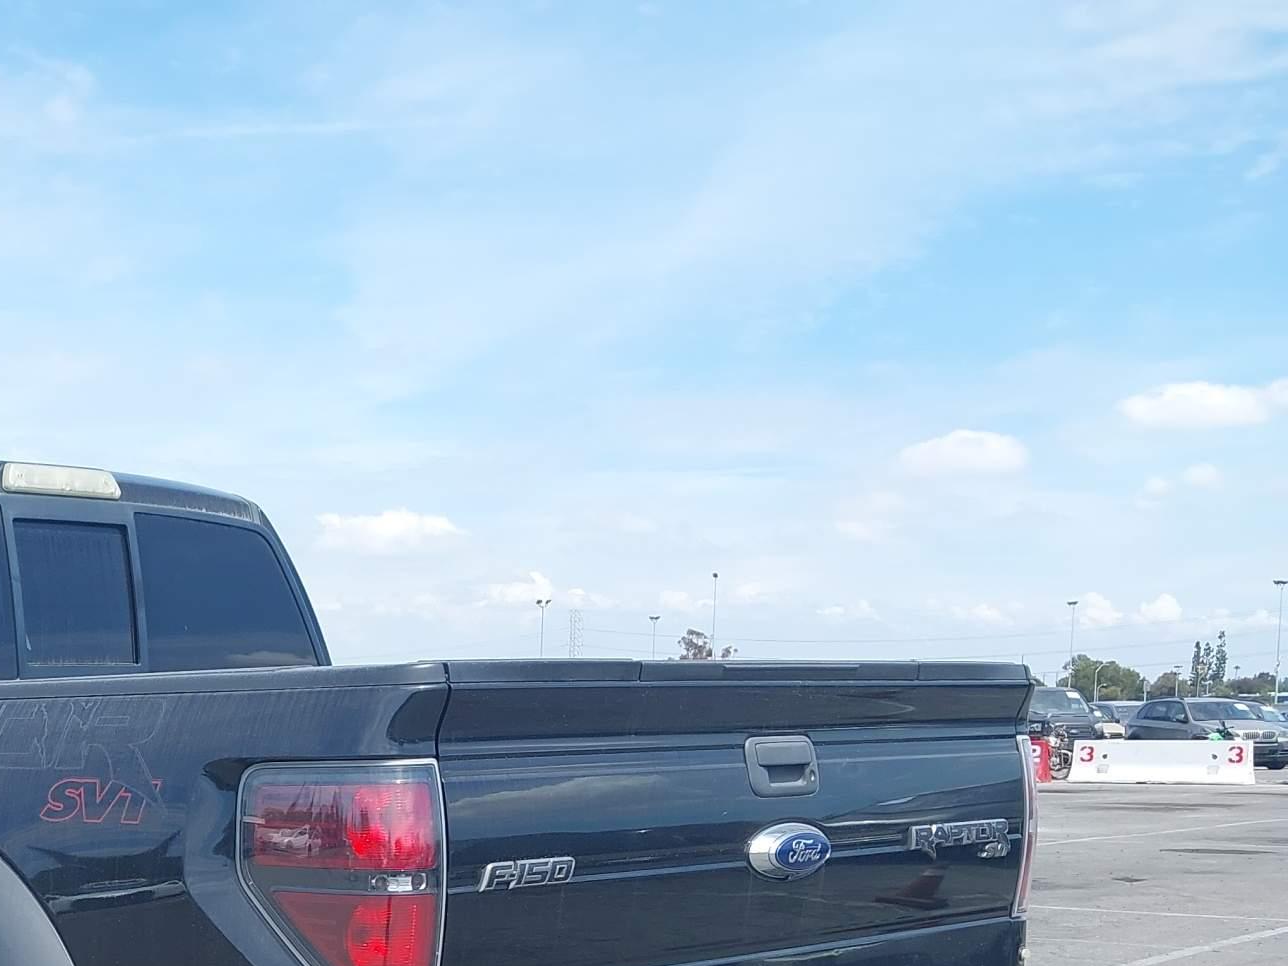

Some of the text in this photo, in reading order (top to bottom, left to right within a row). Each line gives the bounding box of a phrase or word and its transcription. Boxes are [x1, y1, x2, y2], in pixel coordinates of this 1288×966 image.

[1079, 745, 1095, 762] 3
[1227, 745, 1244, 764] 3
[39, 777, 162, 825] SVT
[788, 838, 821, 864] Ford
[909, 818, 1010, 860] RAPTOR
[479, 856, 575, 892] F-150
